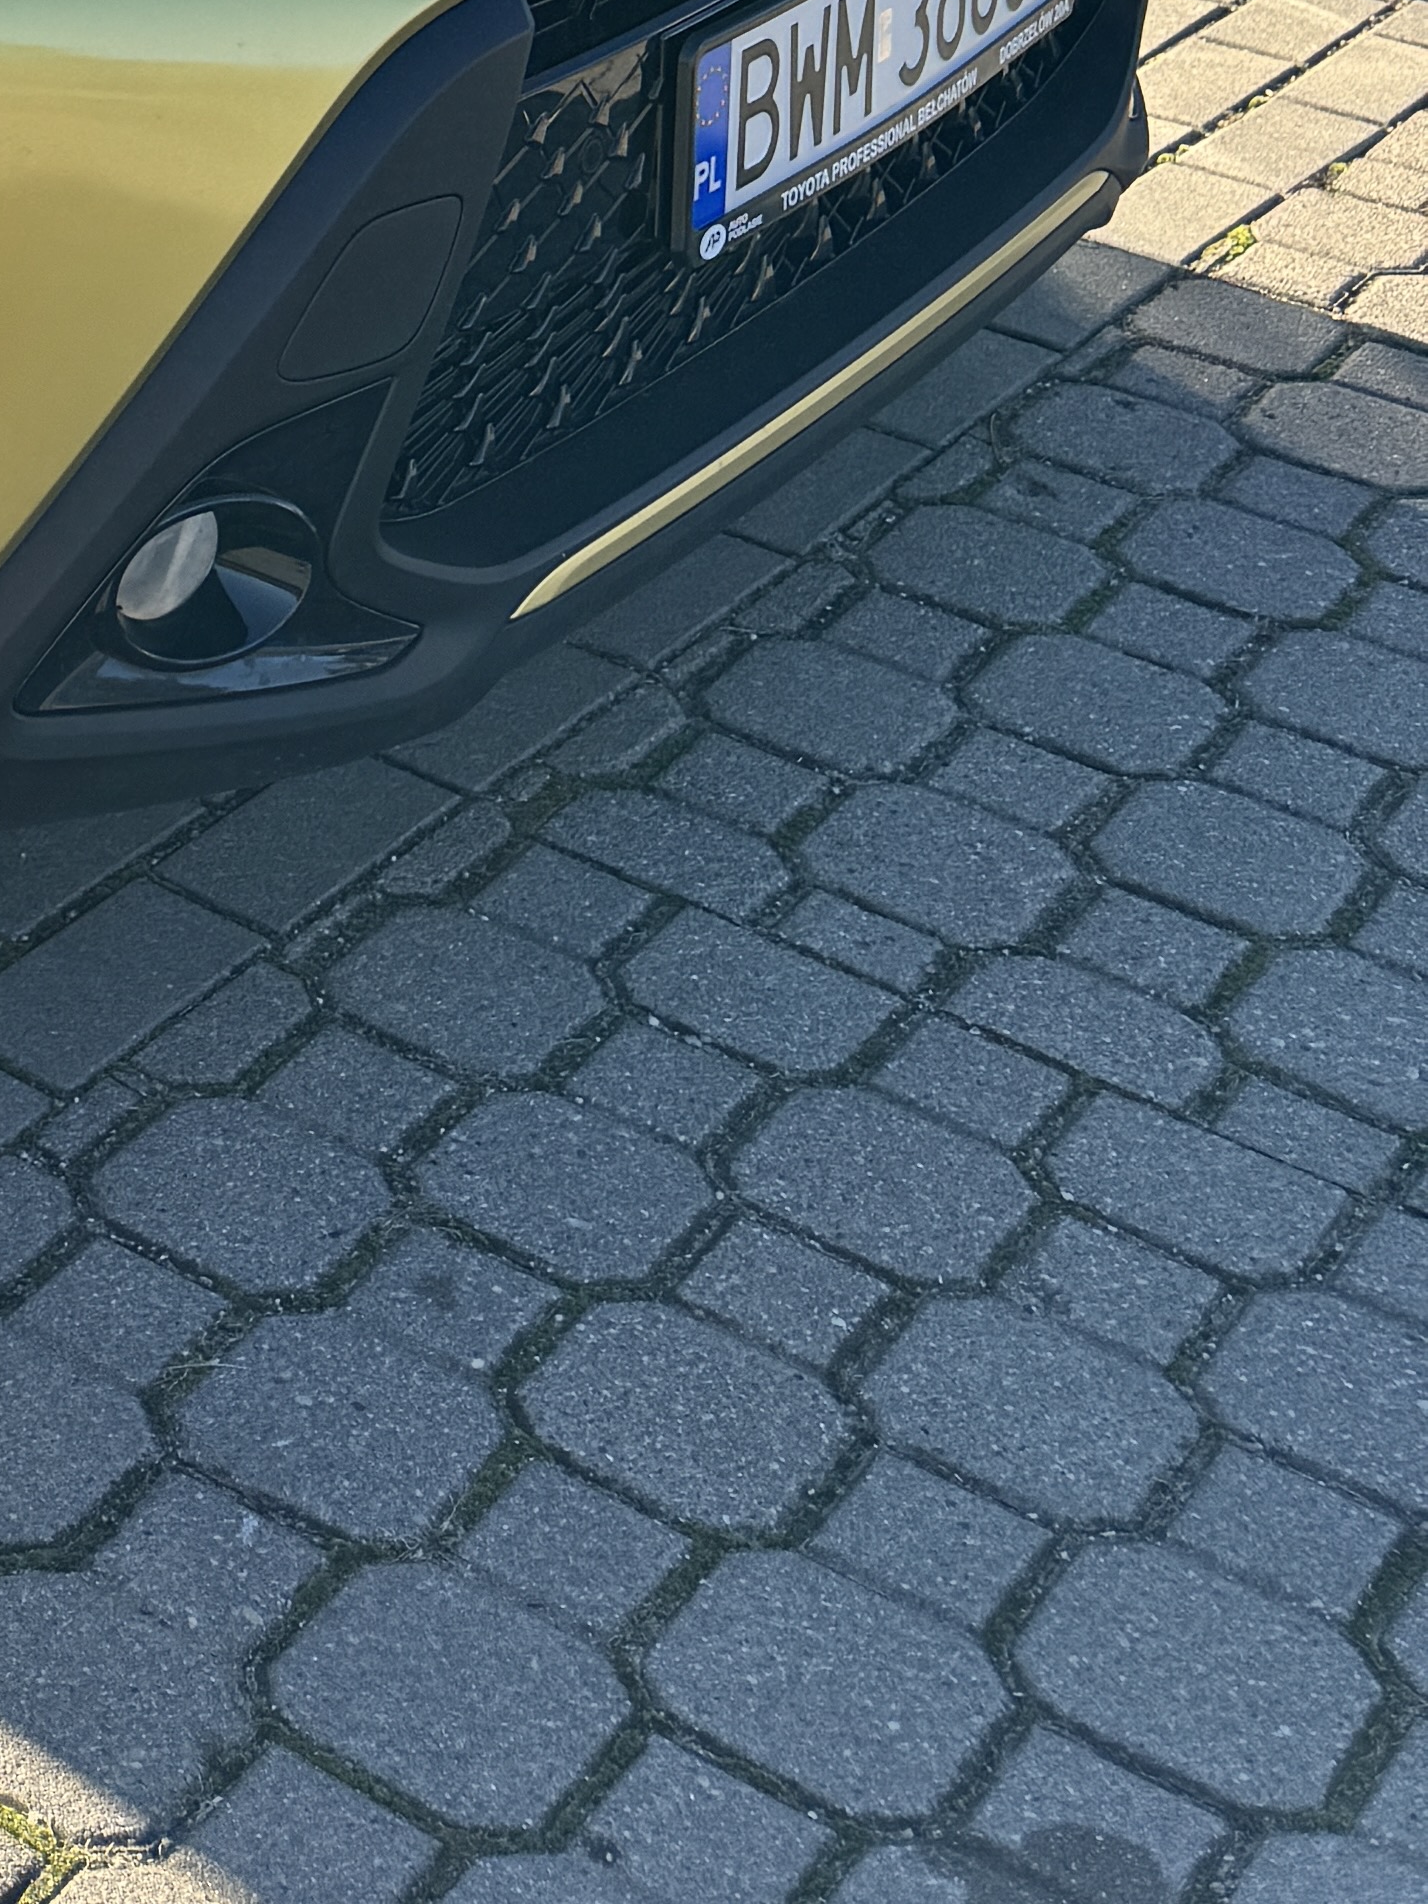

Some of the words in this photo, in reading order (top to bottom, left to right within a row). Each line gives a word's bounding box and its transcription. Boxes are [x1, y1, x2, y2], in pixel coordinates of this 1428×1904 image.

[693, 155, 722, 202] PL
[781, 168, 830, 211] TOYOTA
[832, 114, 916, 181] PROFESSIONAL
